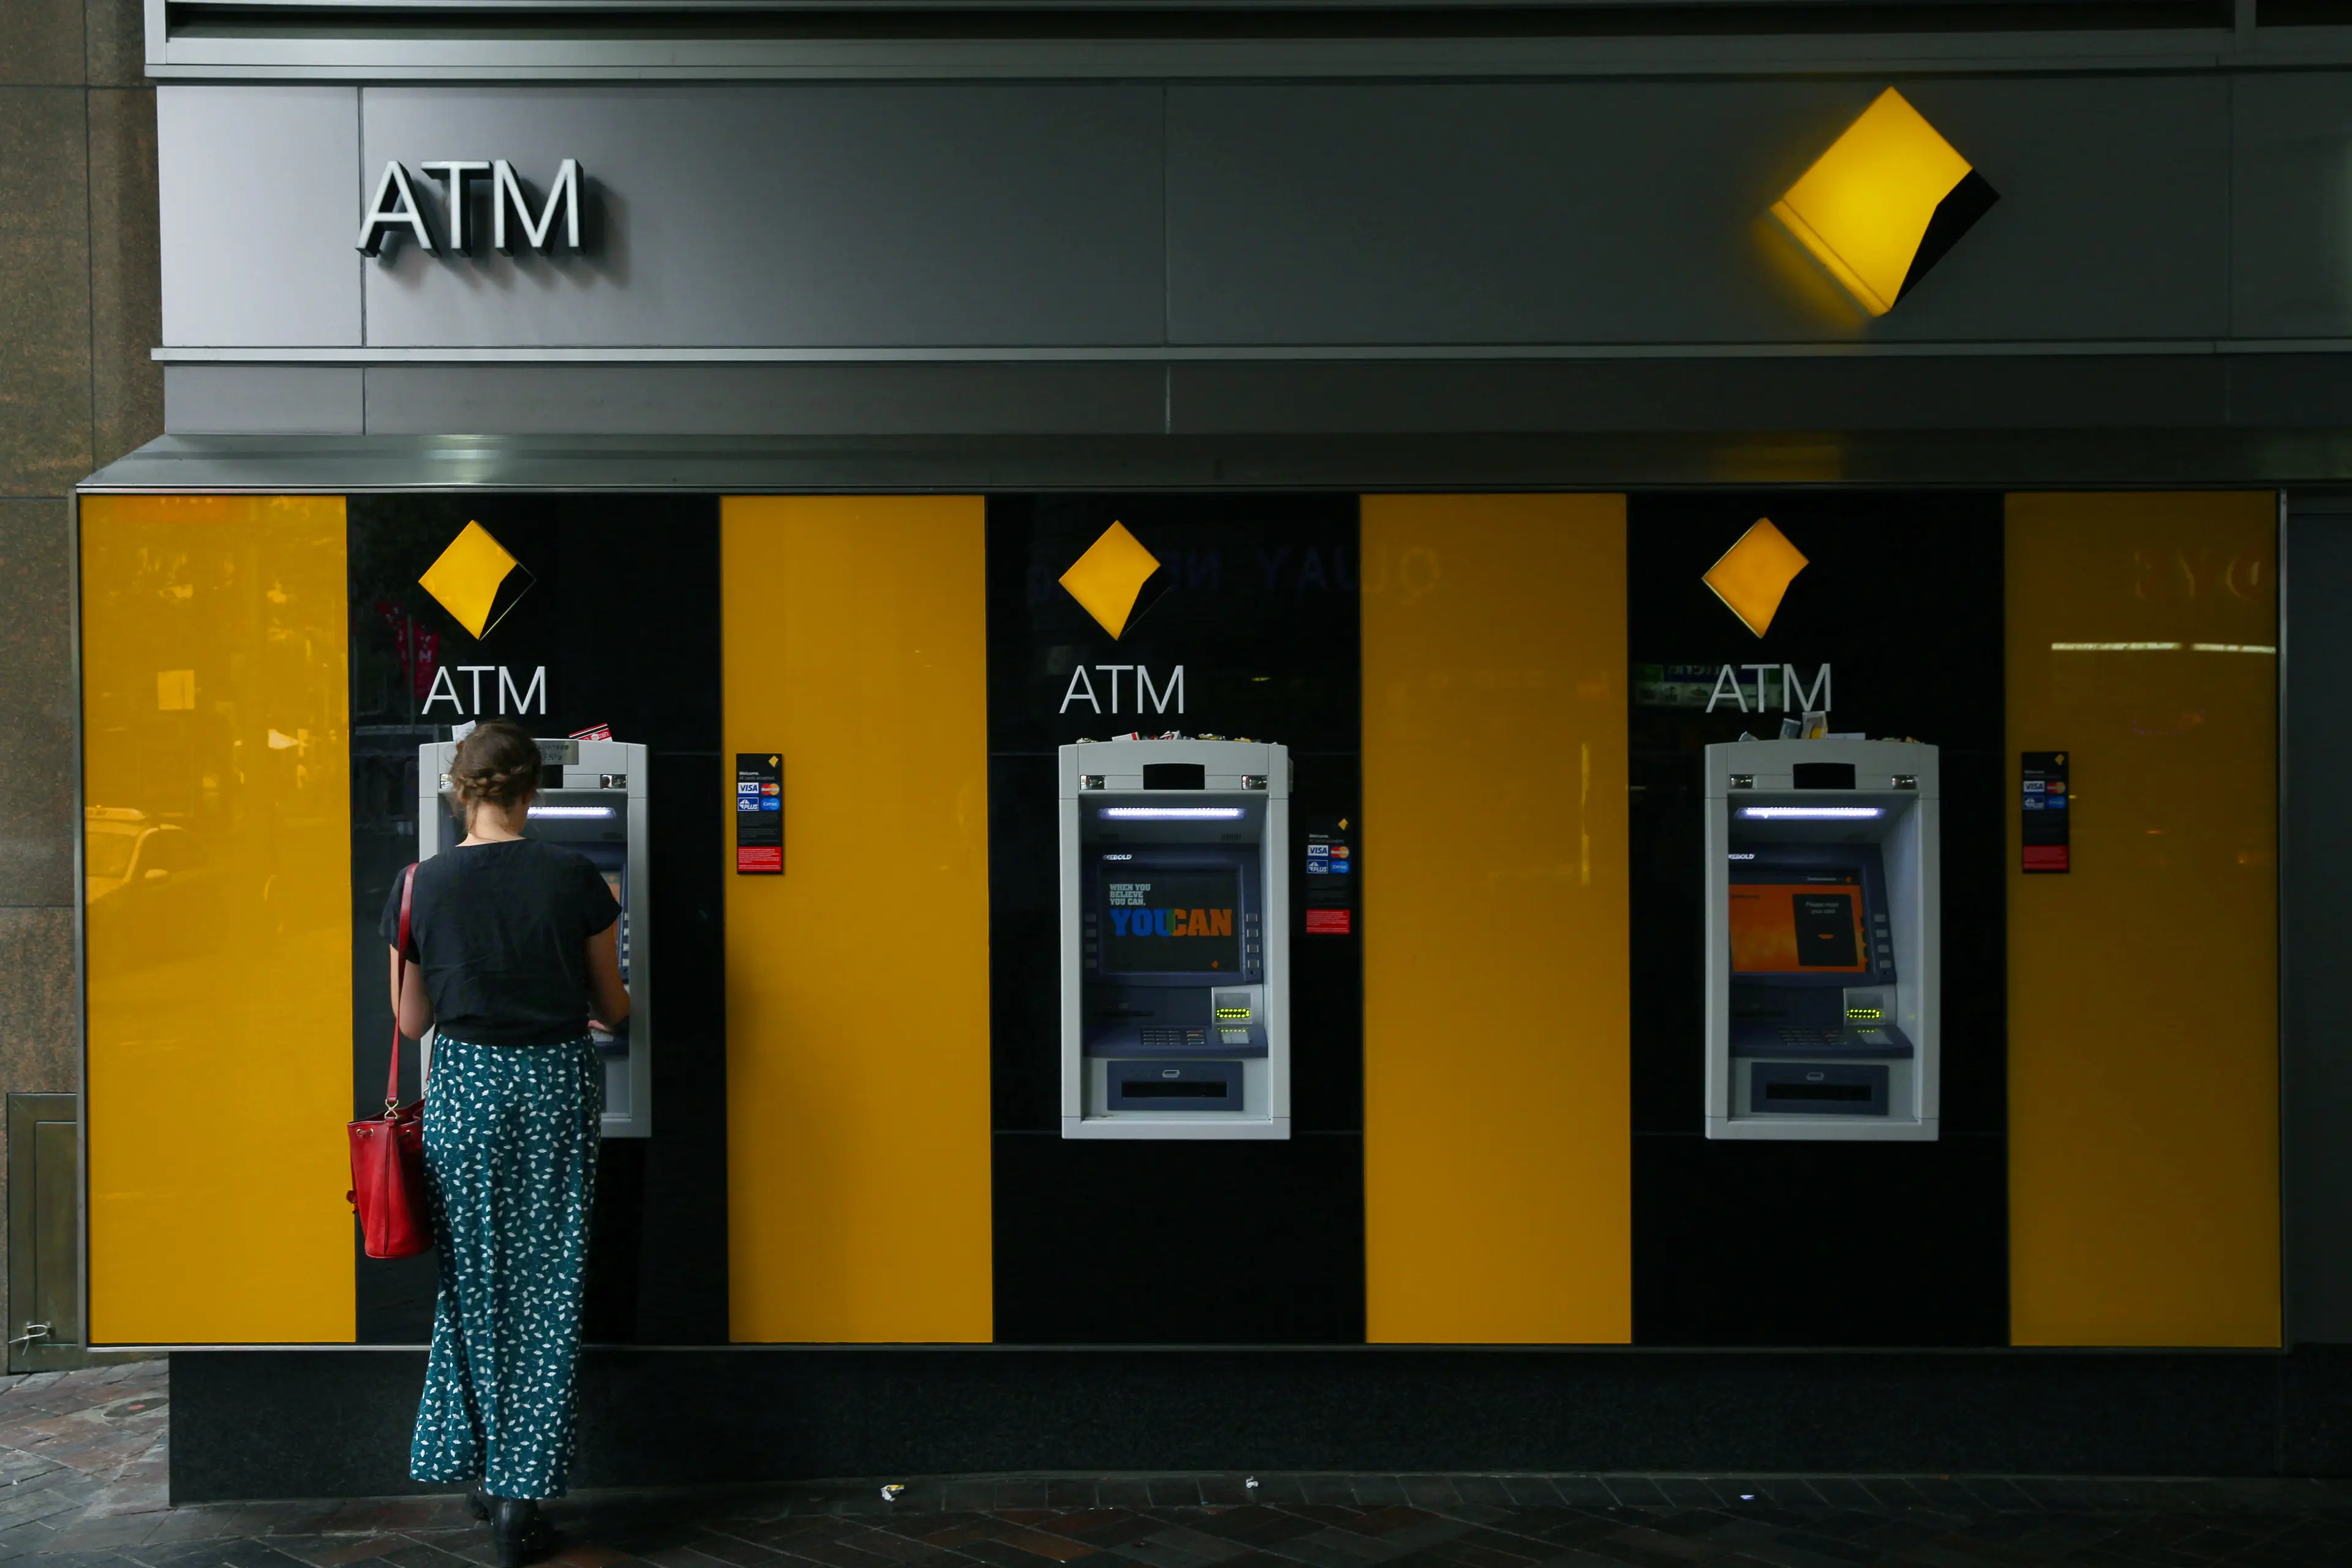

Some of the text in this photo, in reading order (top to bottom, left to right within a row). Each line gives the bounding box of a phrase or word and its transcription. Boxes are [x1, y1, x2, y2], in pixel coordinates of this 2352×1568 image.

[355, 159, 586, 258] ATM
[422, 666, 545, 714] ATM
[1060, 666, 1183, 713] ATM
[1706, 664, 1830, 712] ATM
